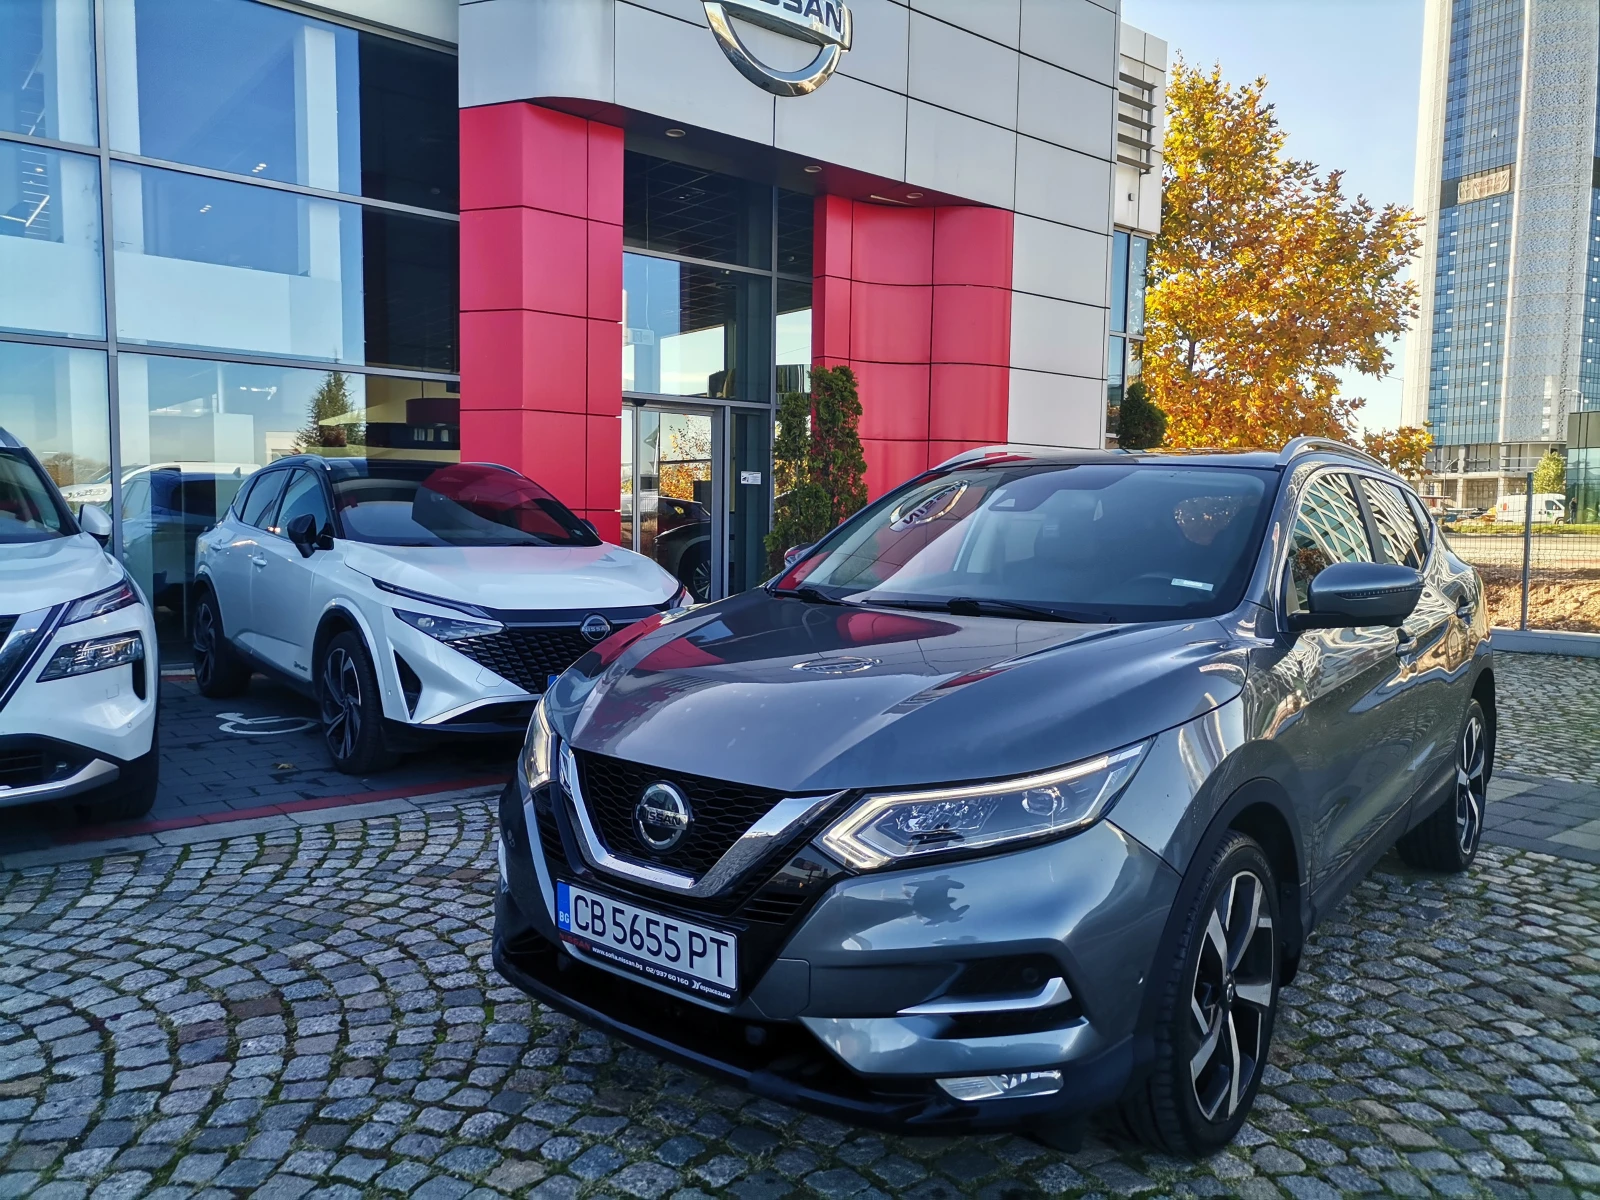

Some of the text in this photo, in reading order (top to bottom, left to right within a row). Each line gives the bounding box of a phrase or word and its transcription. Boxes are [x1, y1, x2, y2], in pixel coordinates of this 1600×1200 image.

[559, 911, 570, 924] BG
[559, 932, 591, 951] NISSAN
[592, 947, 643, 970] www.sofia.nissan.bg
